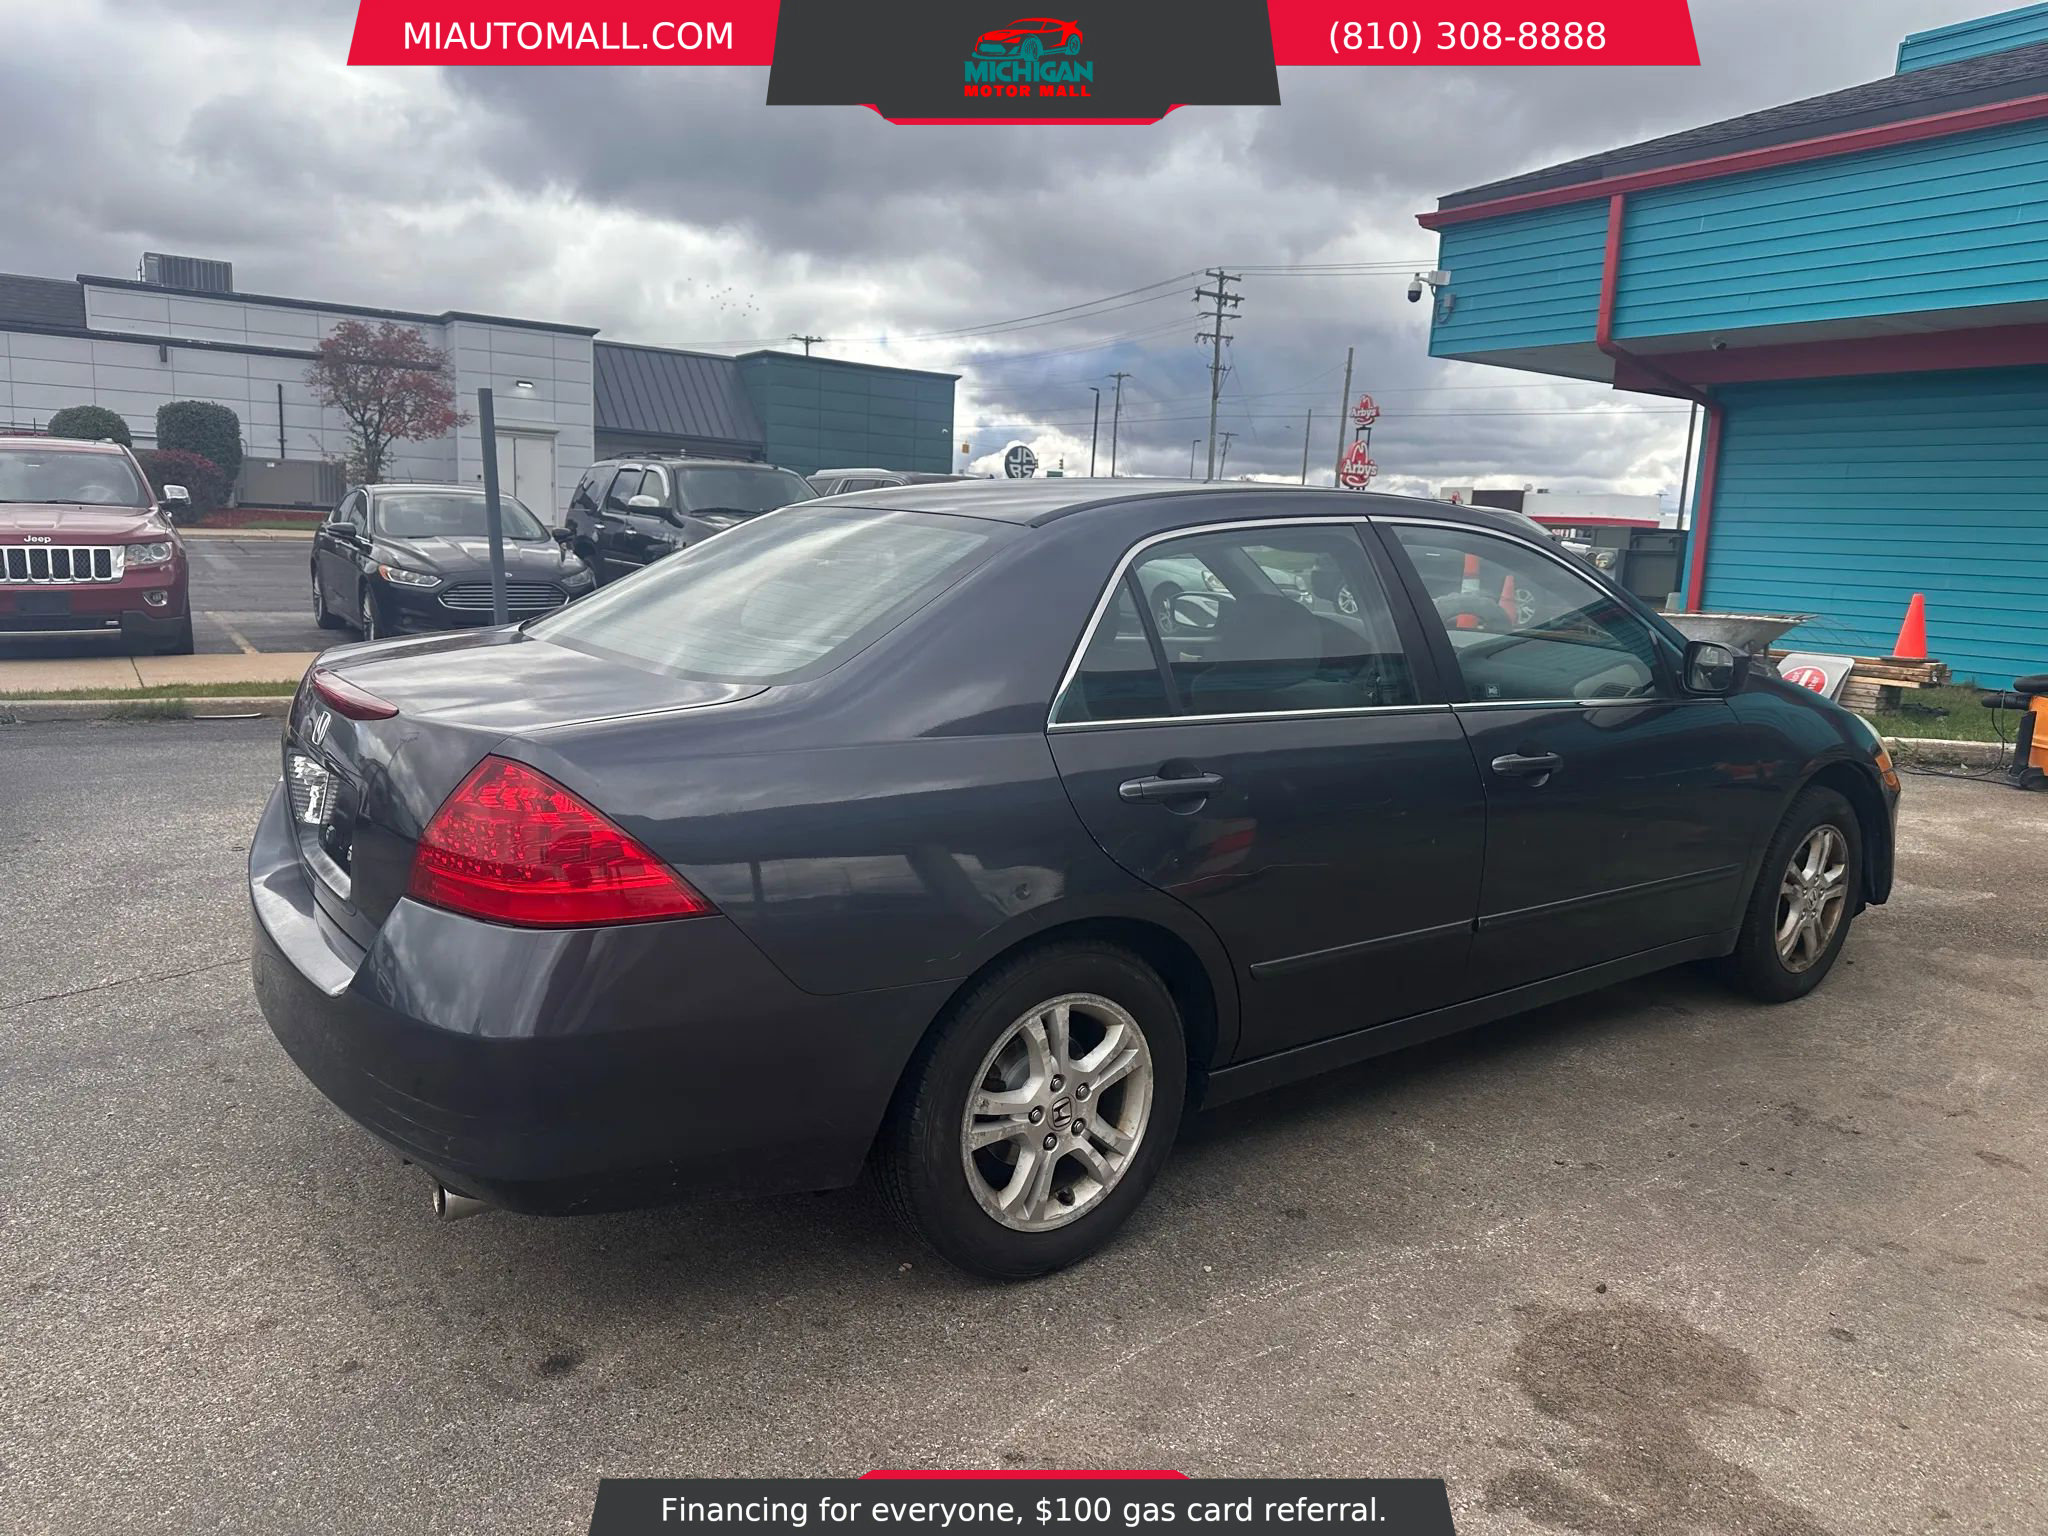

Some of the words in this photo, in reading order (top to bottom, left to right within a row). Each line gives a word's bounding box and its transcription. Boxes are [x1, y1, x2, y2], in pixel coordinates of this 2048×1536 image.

[1350, 407, 1377, 419] Arby's
[1343, 459, 1378, 477] Arby's
[23, 535, 52, 544] Jeep
